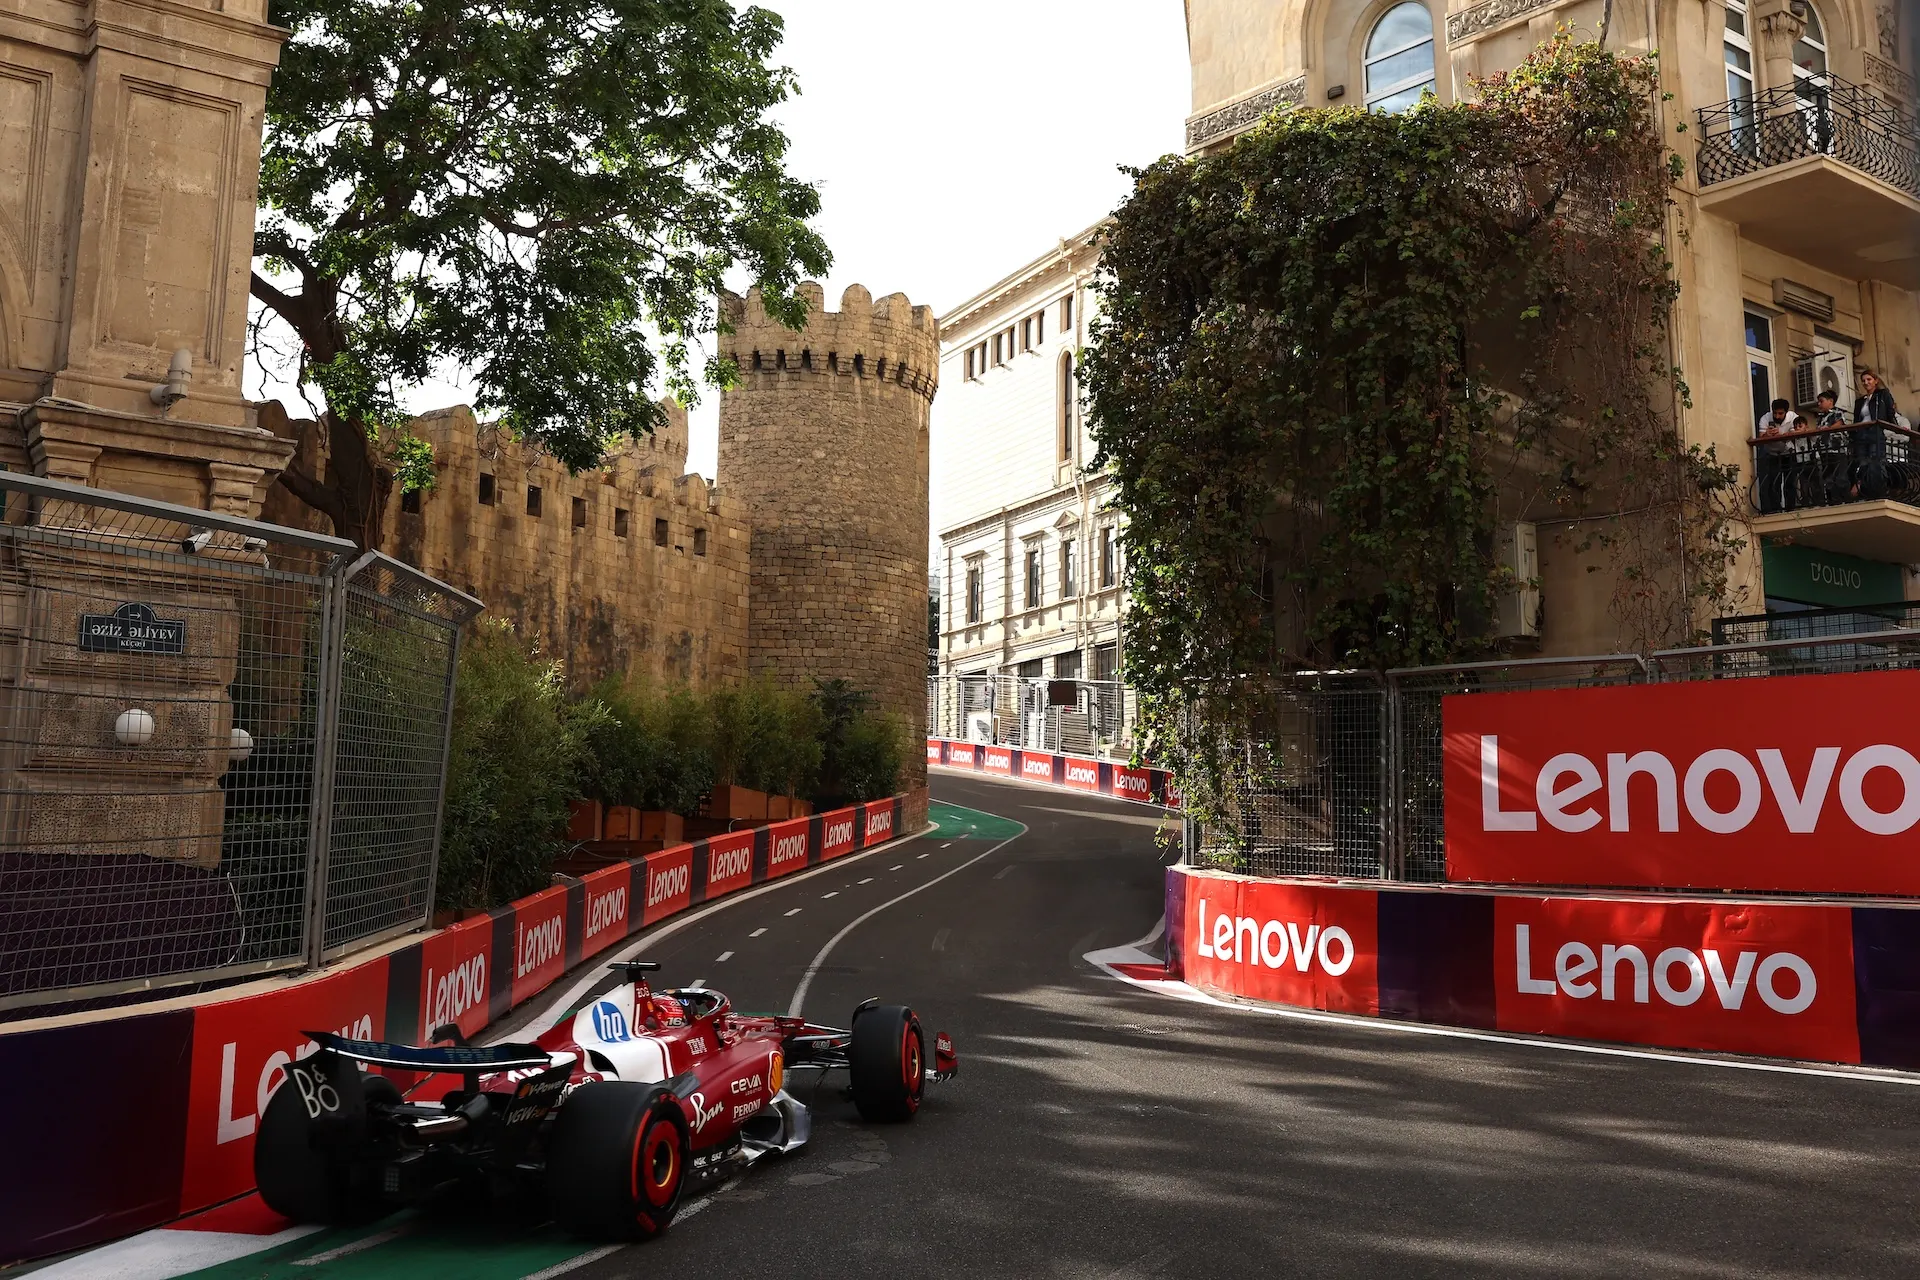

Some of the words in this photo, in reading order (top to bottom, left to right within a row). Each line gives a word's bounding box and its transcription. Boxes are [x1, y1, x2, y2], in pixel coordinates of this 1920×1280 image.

[91, 623, 122, 636] ƏZİZ
[129, 626, 176, 640] ƏLİYEV
[951, 747, 973, 763] Lenovo
[985, 750, 1009, 769] Lenovo
[1023, 756, 1051, 777] Lenovo
[1066, 763, 1096, 784] Lenovo
[1114, 770, 1148, 793] Lenovo
[1481, 735, 1920, 835] Lenovo
[823, 819, 853, 848] Lenovo
[867, 809, 891, 836] Lenovo
[709, 847, 750, 883] Lenovo
[771, 833, 806, 865] Lenovo
[647, 863, 688, 908] Lenovo
[586, 886, 626, 938] Lenovo
[517, 915, 562, 979] Lenovo
[1198, 899, 1354, 977] Lenovo
[1516, 924, 1817, 1015] Lenovo
[424, 952, 486, 1042] Lenovo
[596, 1003, 624, 1042] hp
[733, 1098, 761, 1119] PERONI
